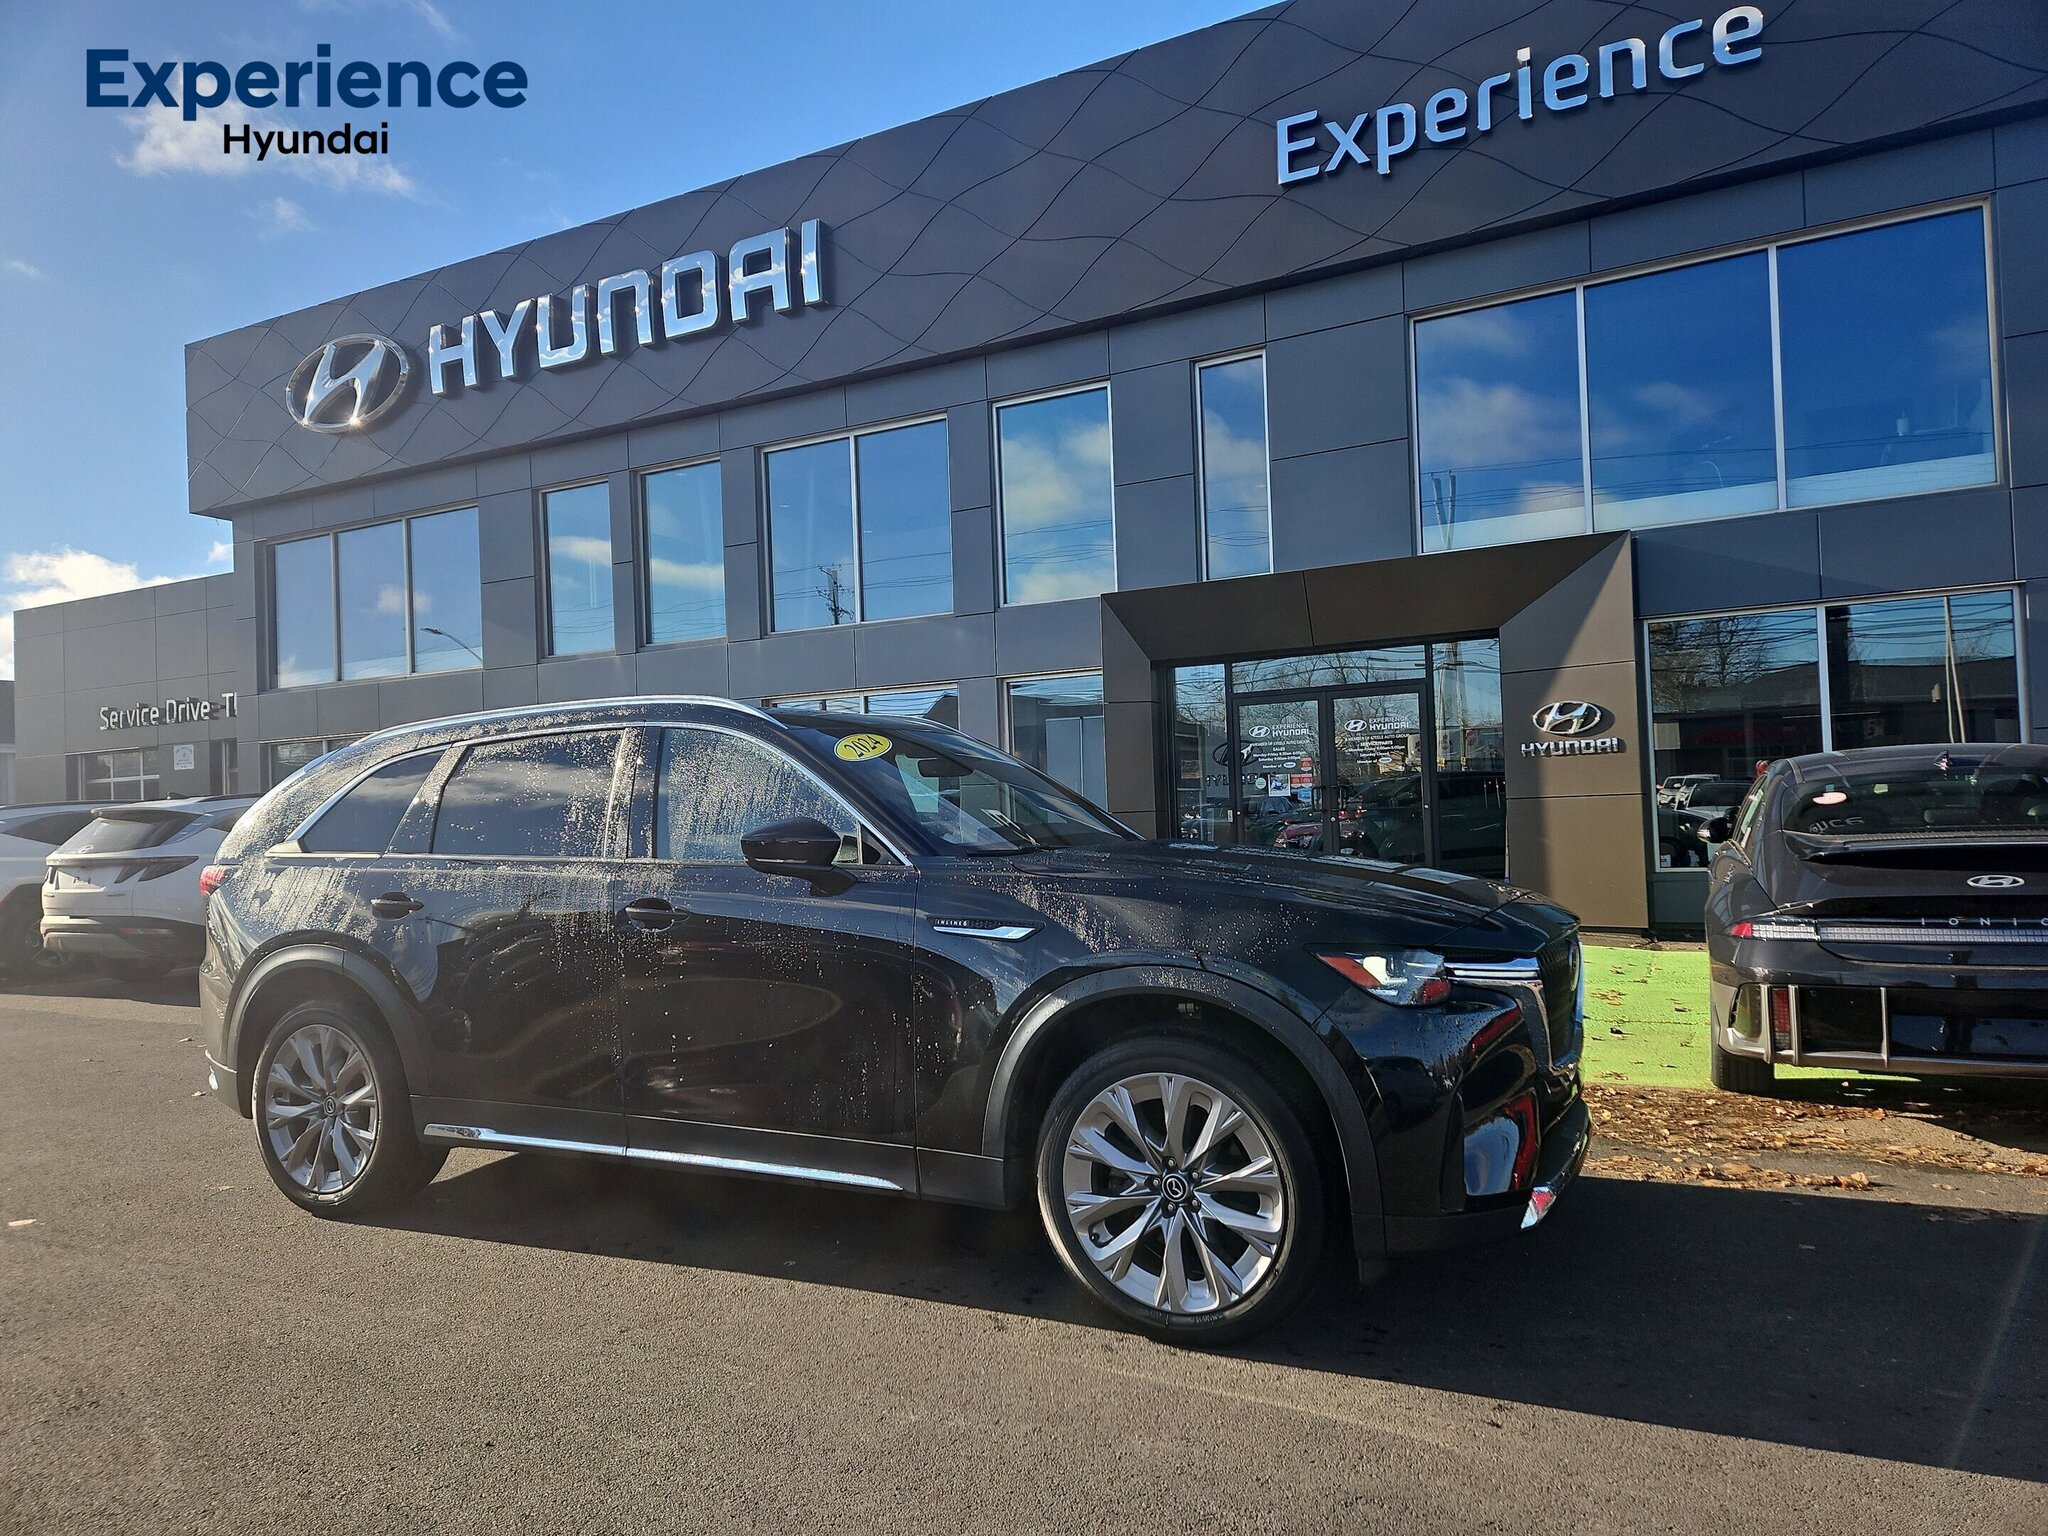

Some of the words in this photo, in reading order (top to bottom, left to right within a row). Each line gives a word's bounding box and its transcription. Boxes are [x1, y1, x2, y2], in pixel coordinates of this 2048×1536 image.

[1276, 5, 1764, 185] Experience
[428, 218, 822, 395] HYUNDAI
[99, 702, 160, 730] Service
[1271, 722, 1309, 730] EXPERIENCE
[1368, 715, 1409, 724] EXPERIENCE
[1369, 721, 1409, 731] HYUNDAI
[1272, 728, 1310, 738] HYUNDAI
[843, 734, 883, 757] 2024
[1520, 737, 1619, 757] HYUNDAI
